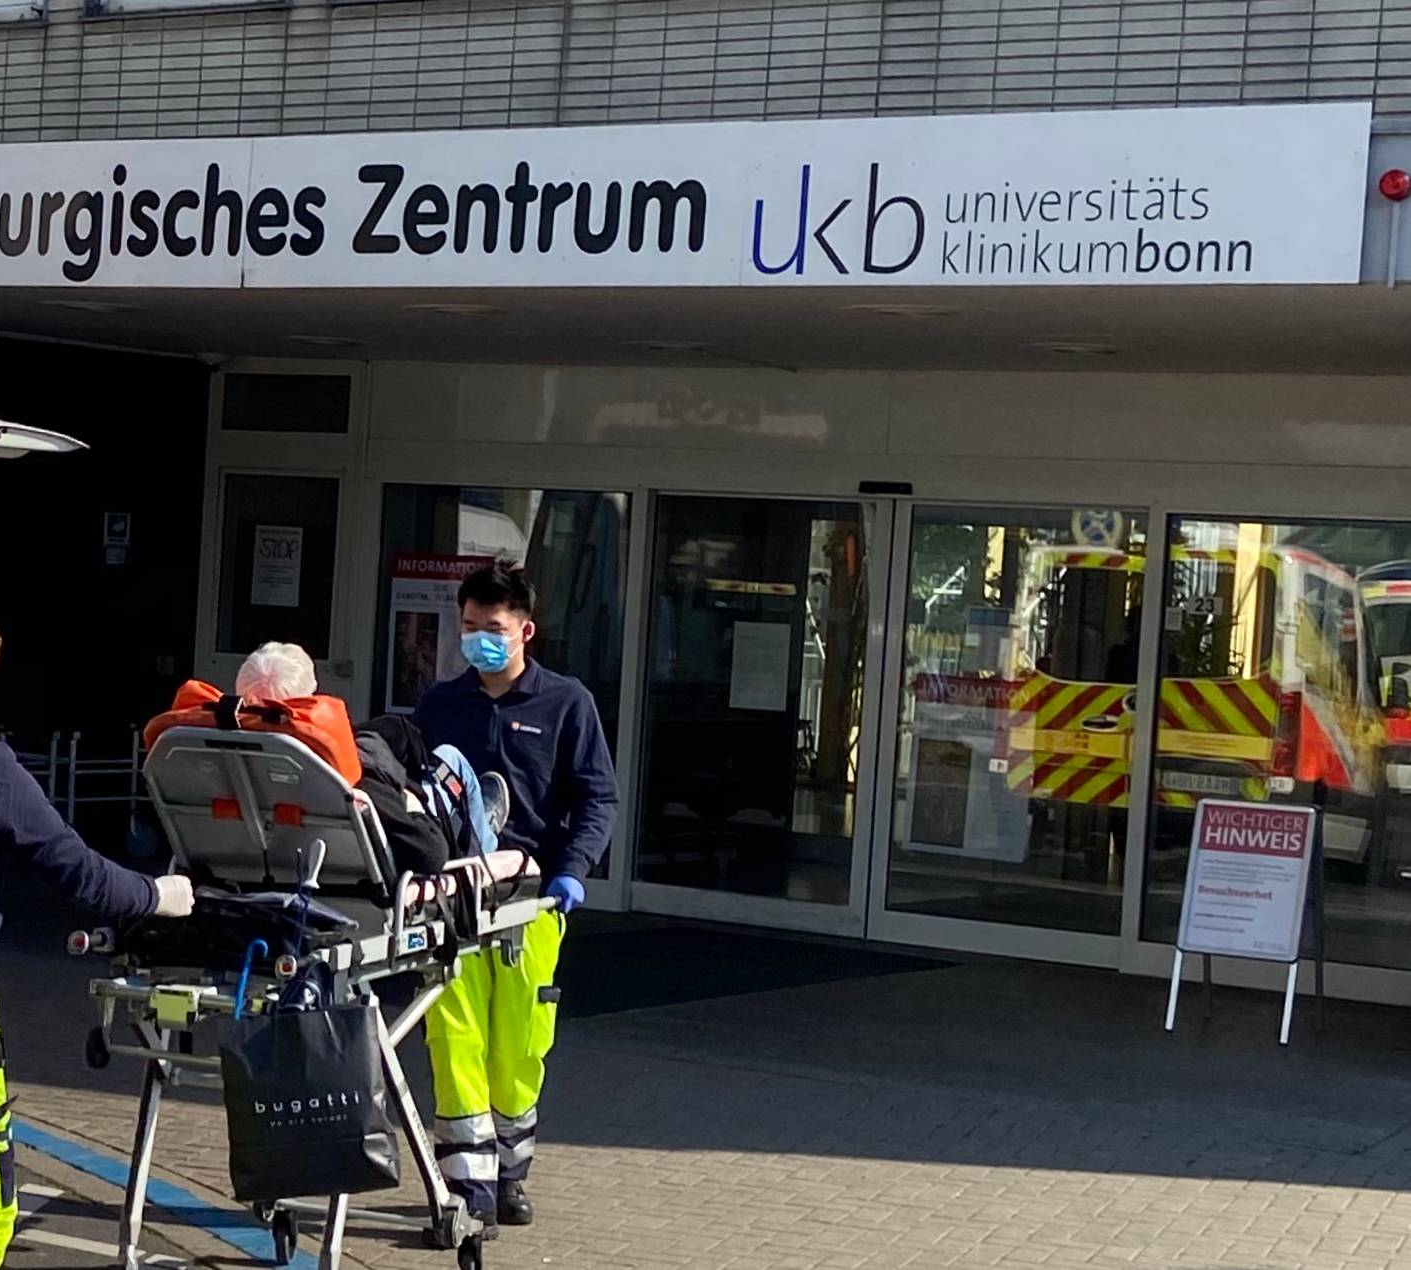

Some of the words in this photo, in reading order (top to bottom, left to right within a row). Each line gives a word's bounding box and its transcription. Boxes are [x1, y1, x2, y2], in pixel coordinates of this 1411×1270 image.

[352, 160, 706, 255] Zentrum
[751, 162, 925, 276] ukb
[944, 176, 1210, 226] universitäts
[941, 227, 1254, 276] klinikumbonn
[1205, 826, 1302, 851] HINWEIS
[1207, 809, 1305, 832] WICHTIGER
[254, 1090, 360, 1114] bugatti
